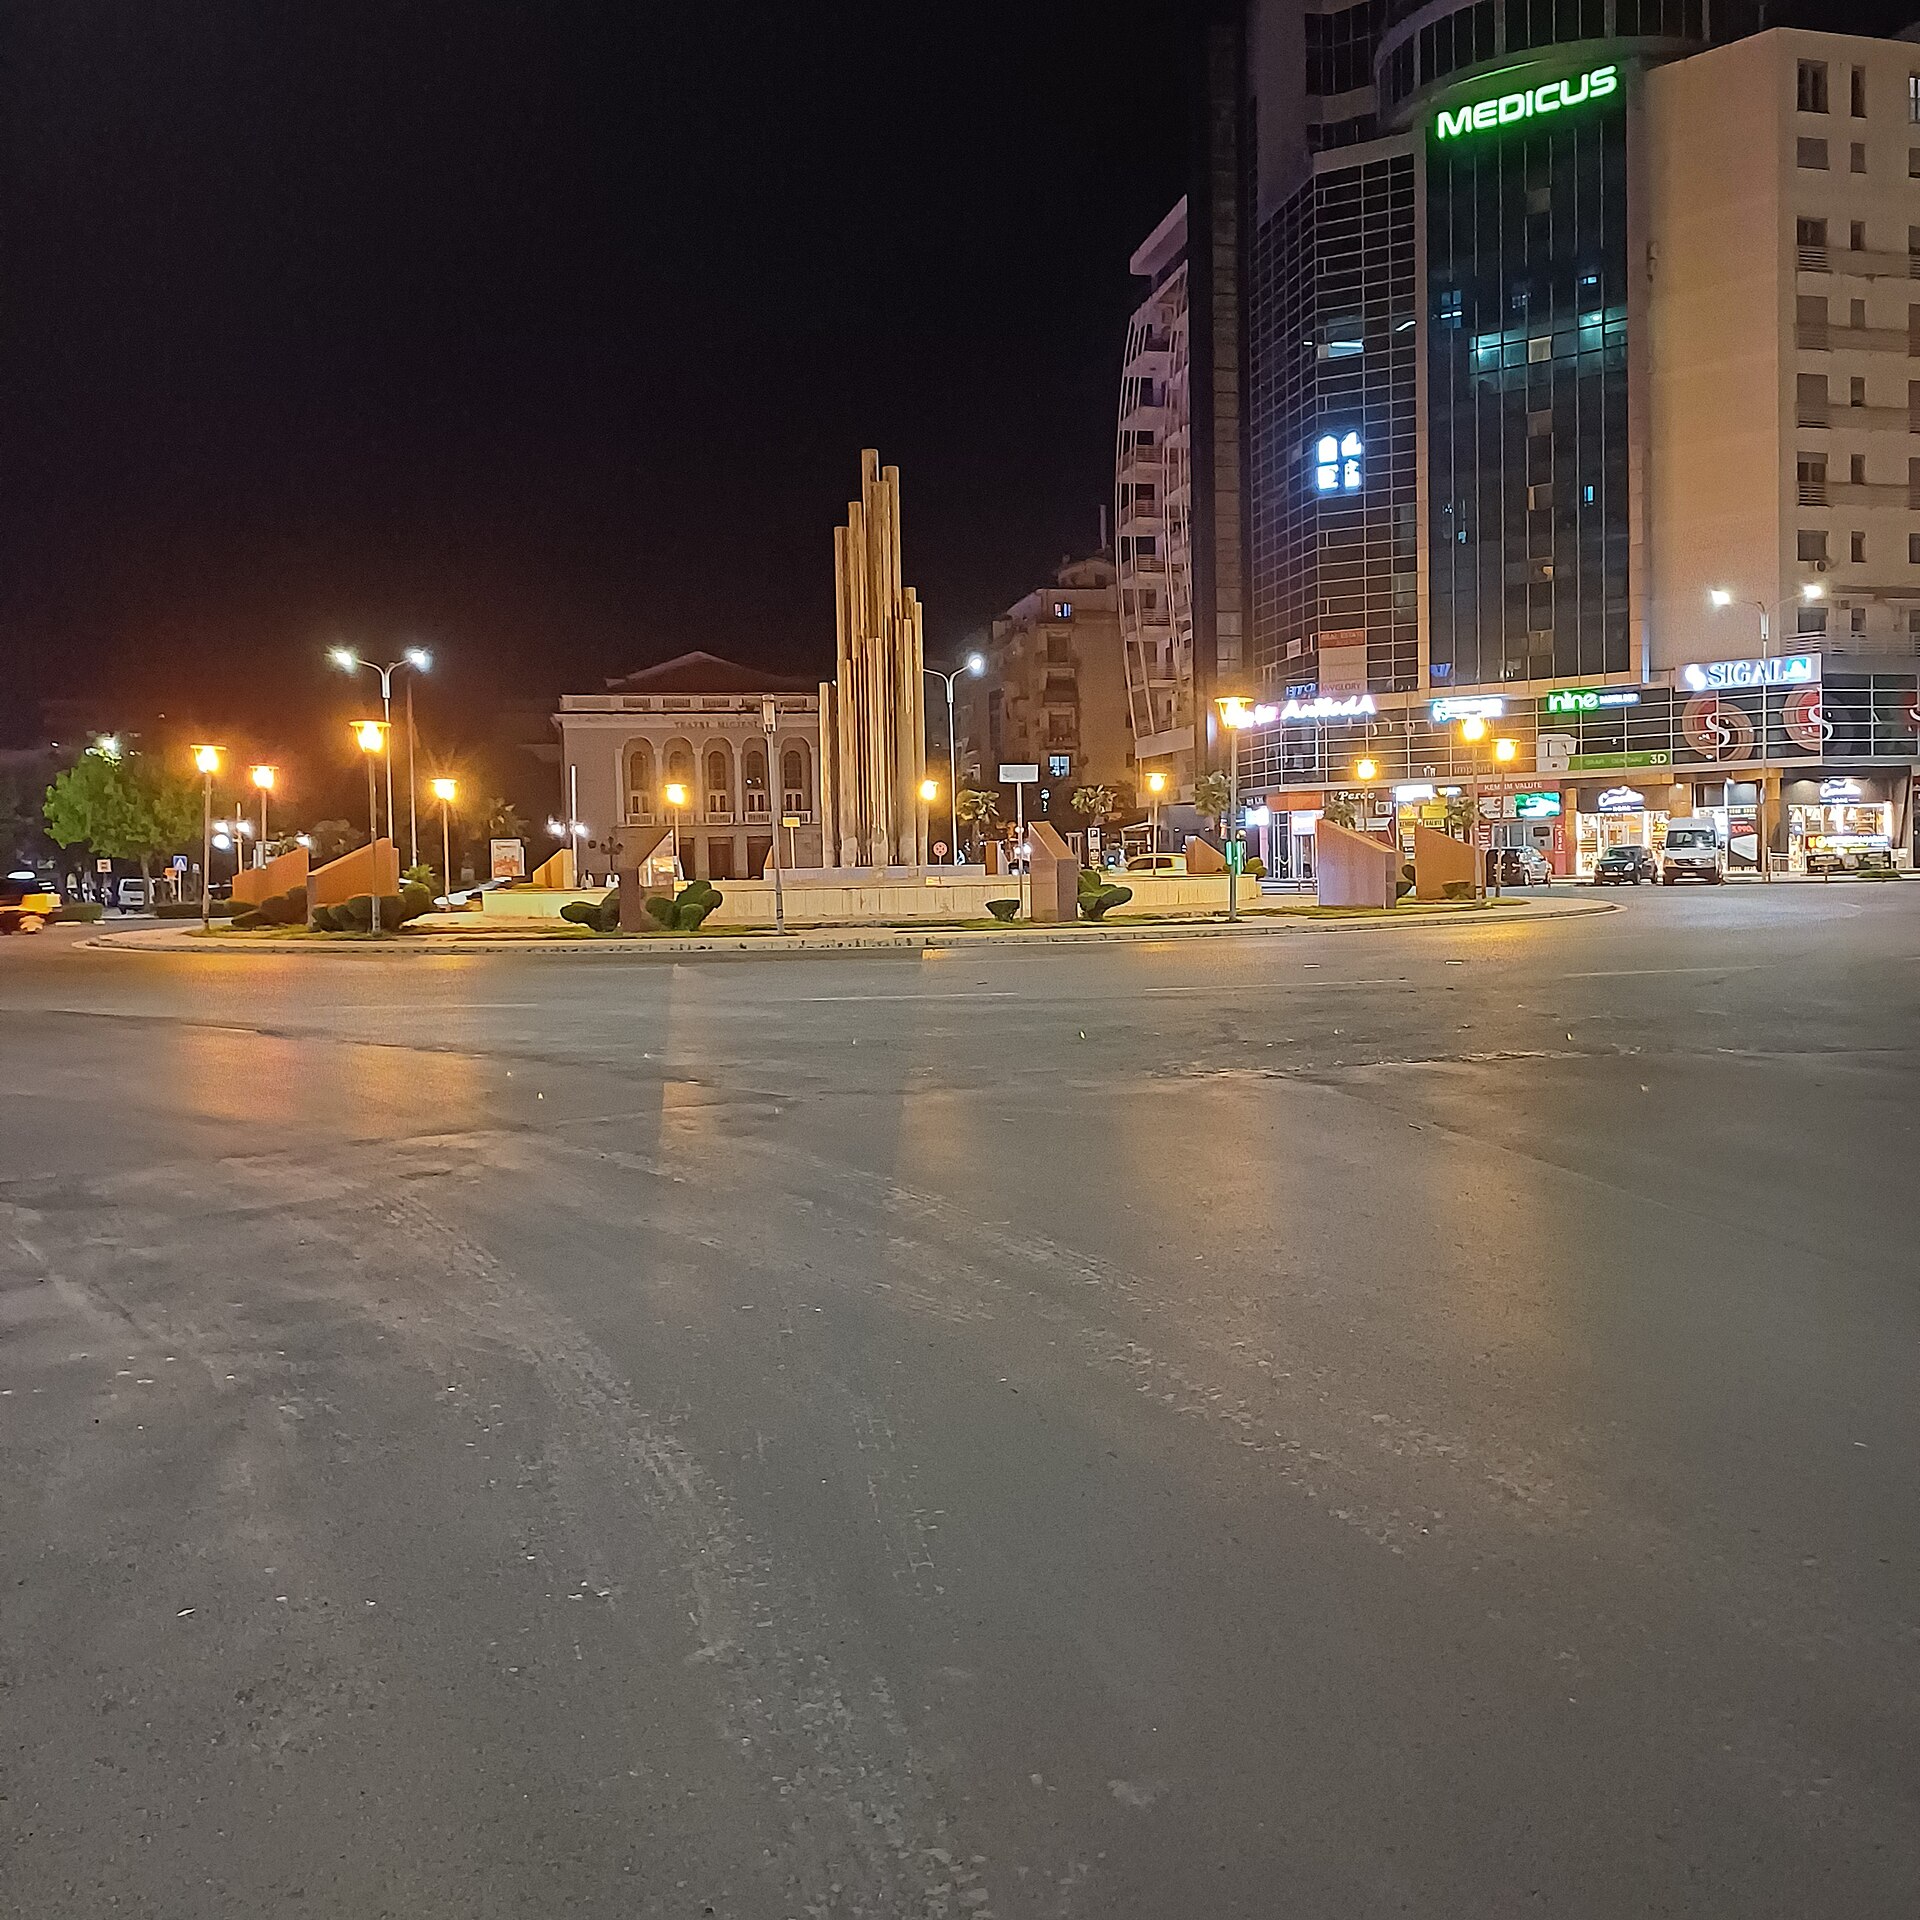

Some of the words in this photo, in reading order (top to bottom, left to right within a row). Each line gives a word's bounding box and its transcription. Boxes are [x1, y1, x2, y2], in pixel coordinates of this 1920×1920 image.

[1437, 65, 1617, 140] MEDICUS
[1706, 659, 1787, 687] SIGAL
[1649, 753, 1667, 764] 3D
[1454, 763, 1492, 776] impant
